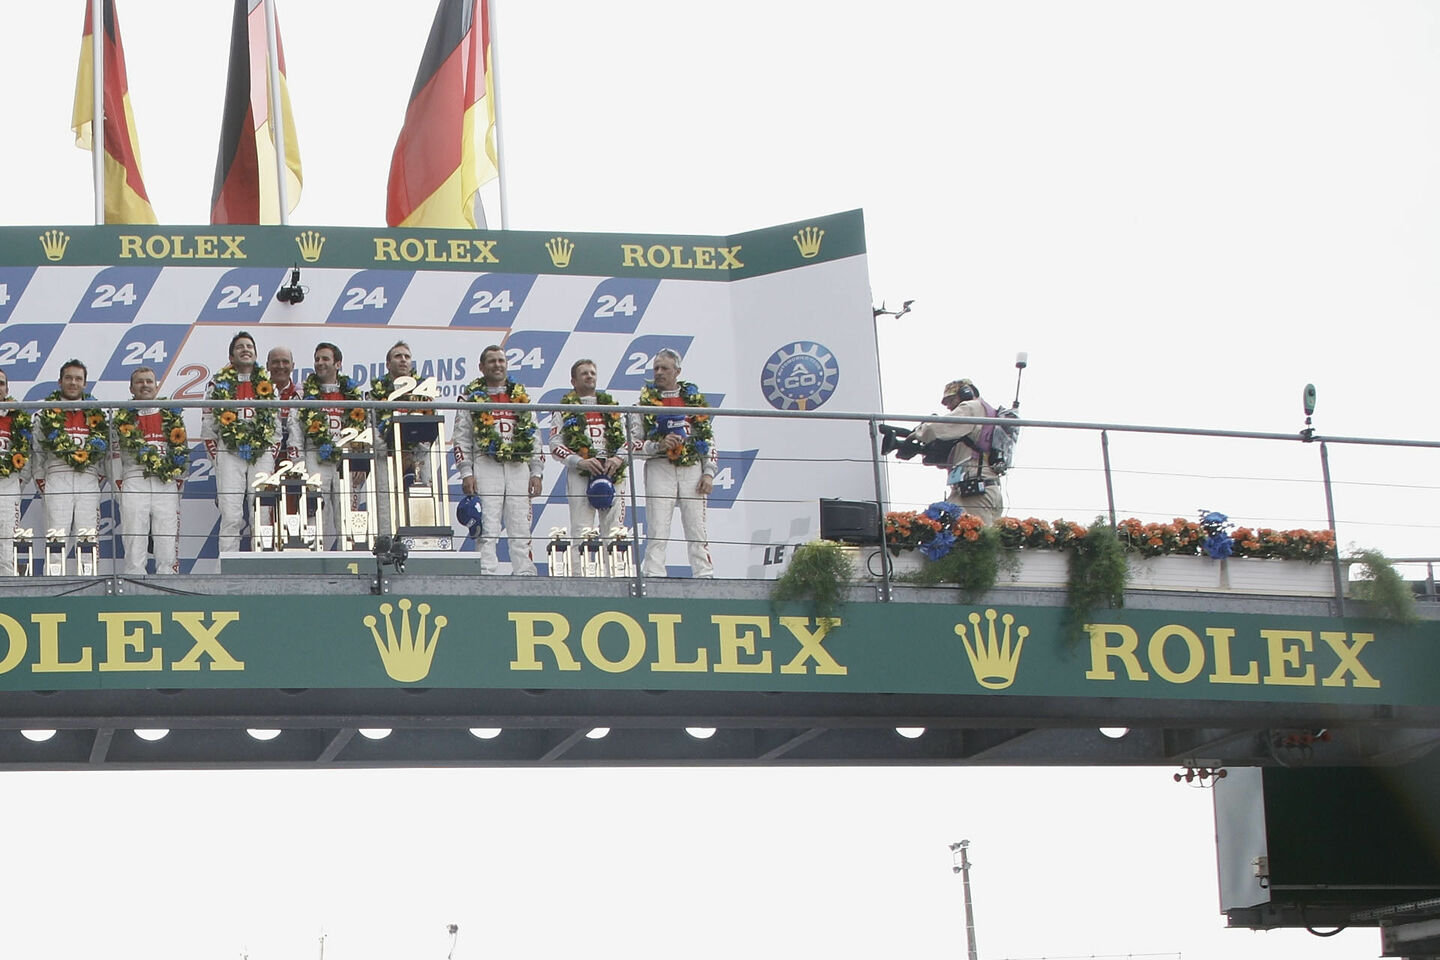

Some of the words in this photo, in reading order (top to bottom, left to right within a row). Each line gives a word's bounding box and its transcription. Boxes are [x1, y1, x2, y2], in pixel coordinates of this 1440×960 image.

[119, 235, 247, 259] ROLEX
[373, 238, 499, 264] ROLEX
[621, 244, 744, 270] ROLEX
[91, 284, 137, 309] 24
[217, 285, 262, 309] 24
[342, 287, 388, 310] 24
[469, 290, 514, 314] 24
[593, 294, 638, 317] 24
[121, 340, 167, 364] 24
[505, 347, 545, 371] 24
[388, 376, 440, 401] 24
[337, 427, 374, 447] 24
[188, 458, 216, 483] 2
[275, 460, 307, 478] 24
[712, 467, 735, 490] 4
[763, 545, 785, 566] LE
[508, 611, 848, 676] ROLEX
[1082, 624, 1381, 689] ROLEX
